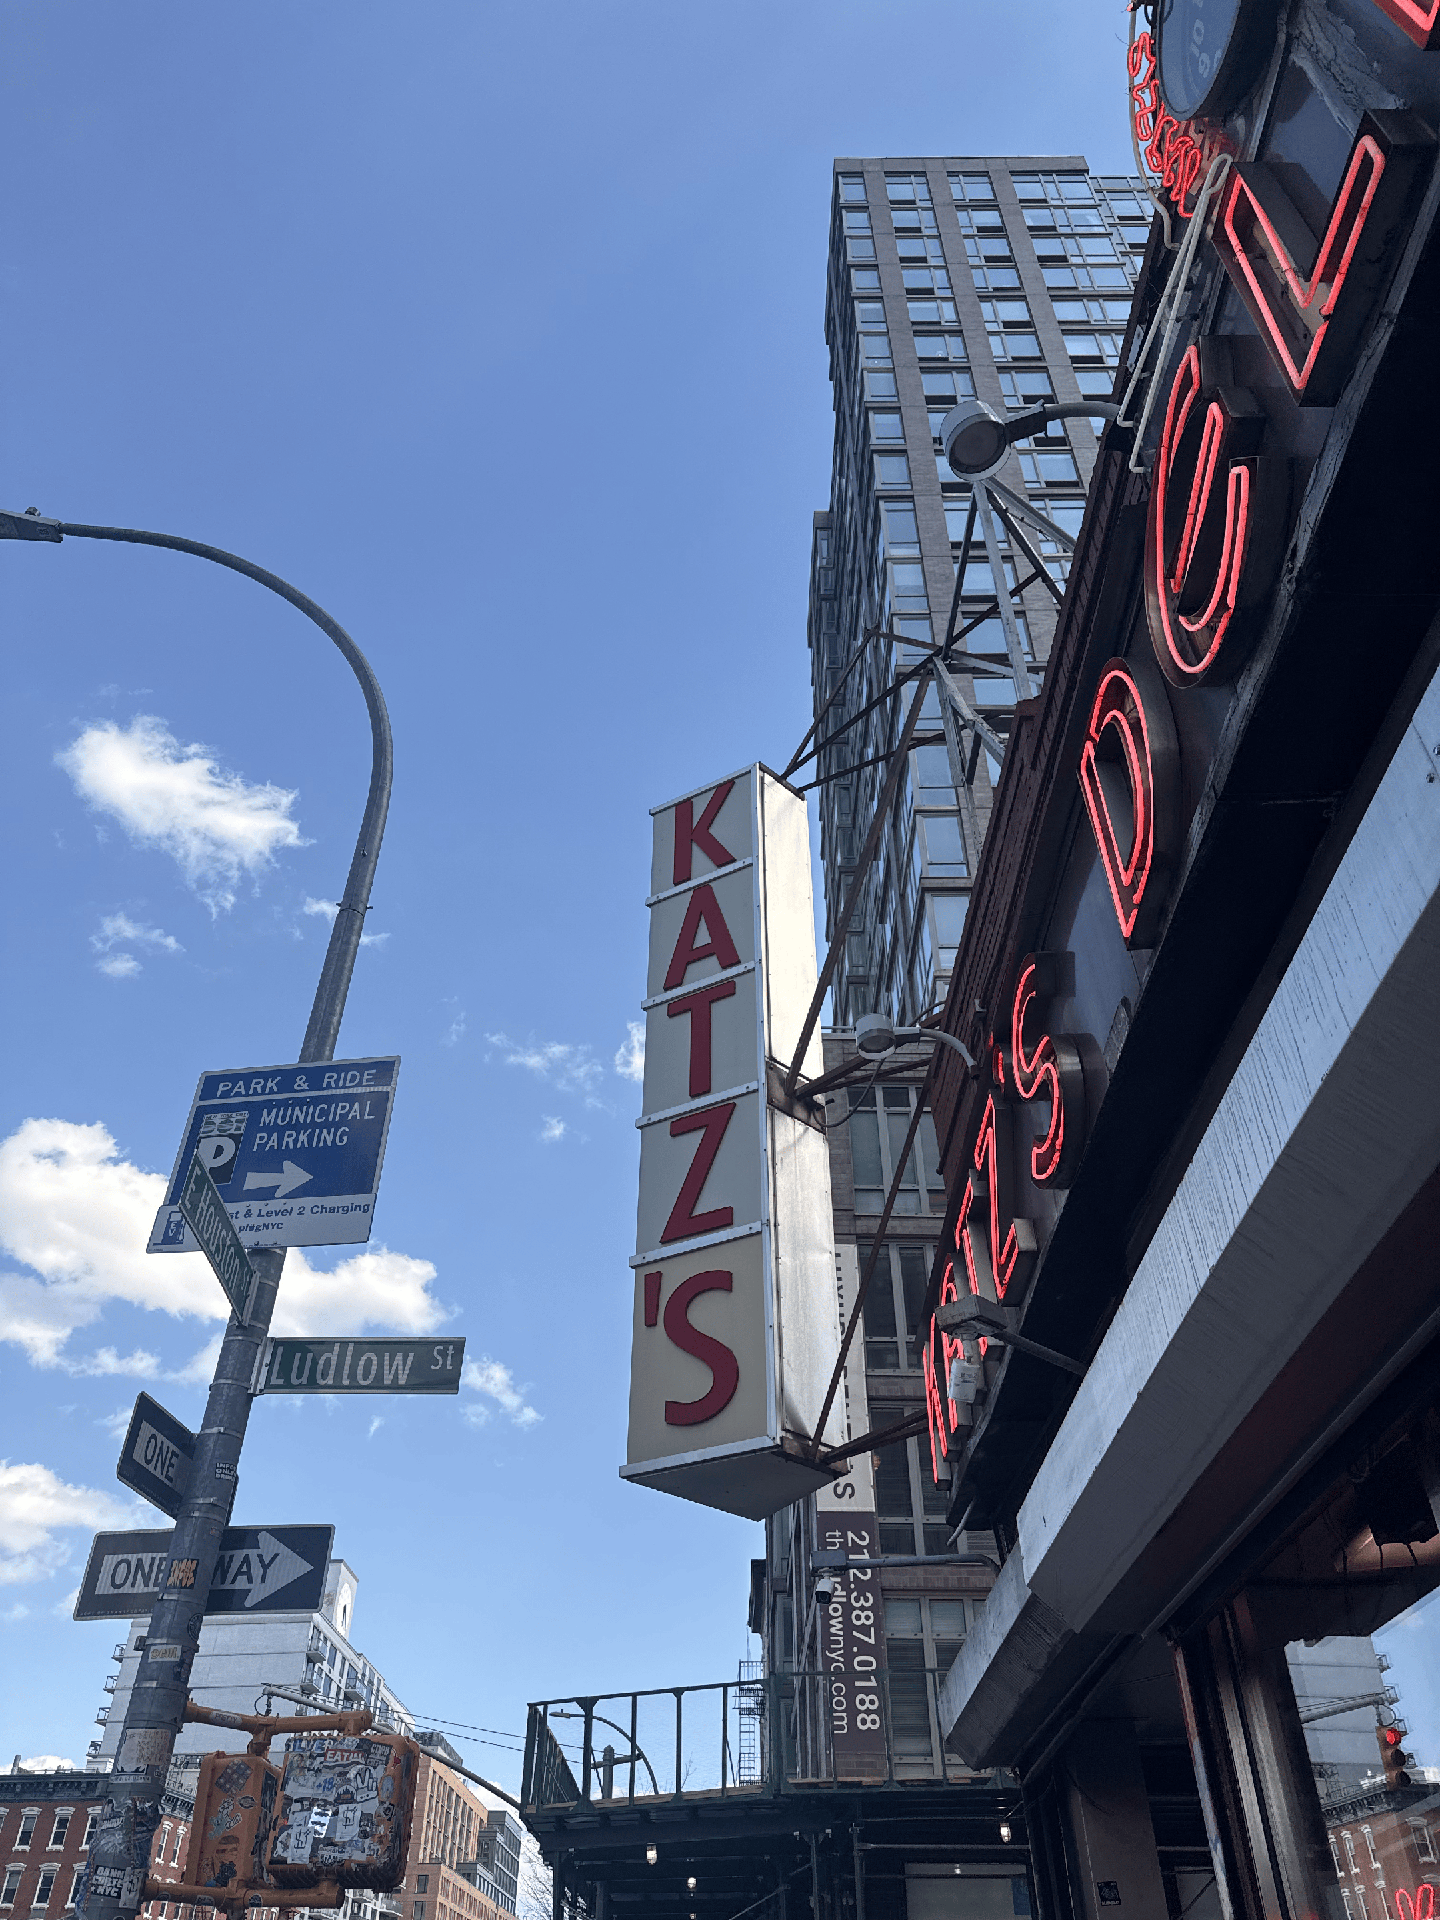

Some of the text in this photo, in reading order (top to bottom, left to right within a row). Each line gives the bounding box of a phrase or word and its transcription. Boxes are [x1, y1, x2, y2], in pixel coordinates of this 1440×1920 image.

[216, 1068, 378, 1098] PARK & RIDE
[644, 778, 741, 1428] KATZ'S
[259, 1099, 376, 1128] MUNICIPAL
[252, 1126, 350, 1152] PARKING
[185, 1164, 202, 1210] E
[195, 1182, 240, 1294] Houston
[243, 1208, 255, 1219] &
[257, 1205, 294, 1218] Level
[297, 1205, 306, 1216] 2
[310, 1201, 371, 1217] Charging
[269, 1342, 456, 1386] Ludlow St
[143, 1433, 180, 1485] ONE
[110, 1556, 167, 1590] ONE
[211, 1552, 281, 1587] WAY
[847, 1530, 881, 1731] 212.387.0188
